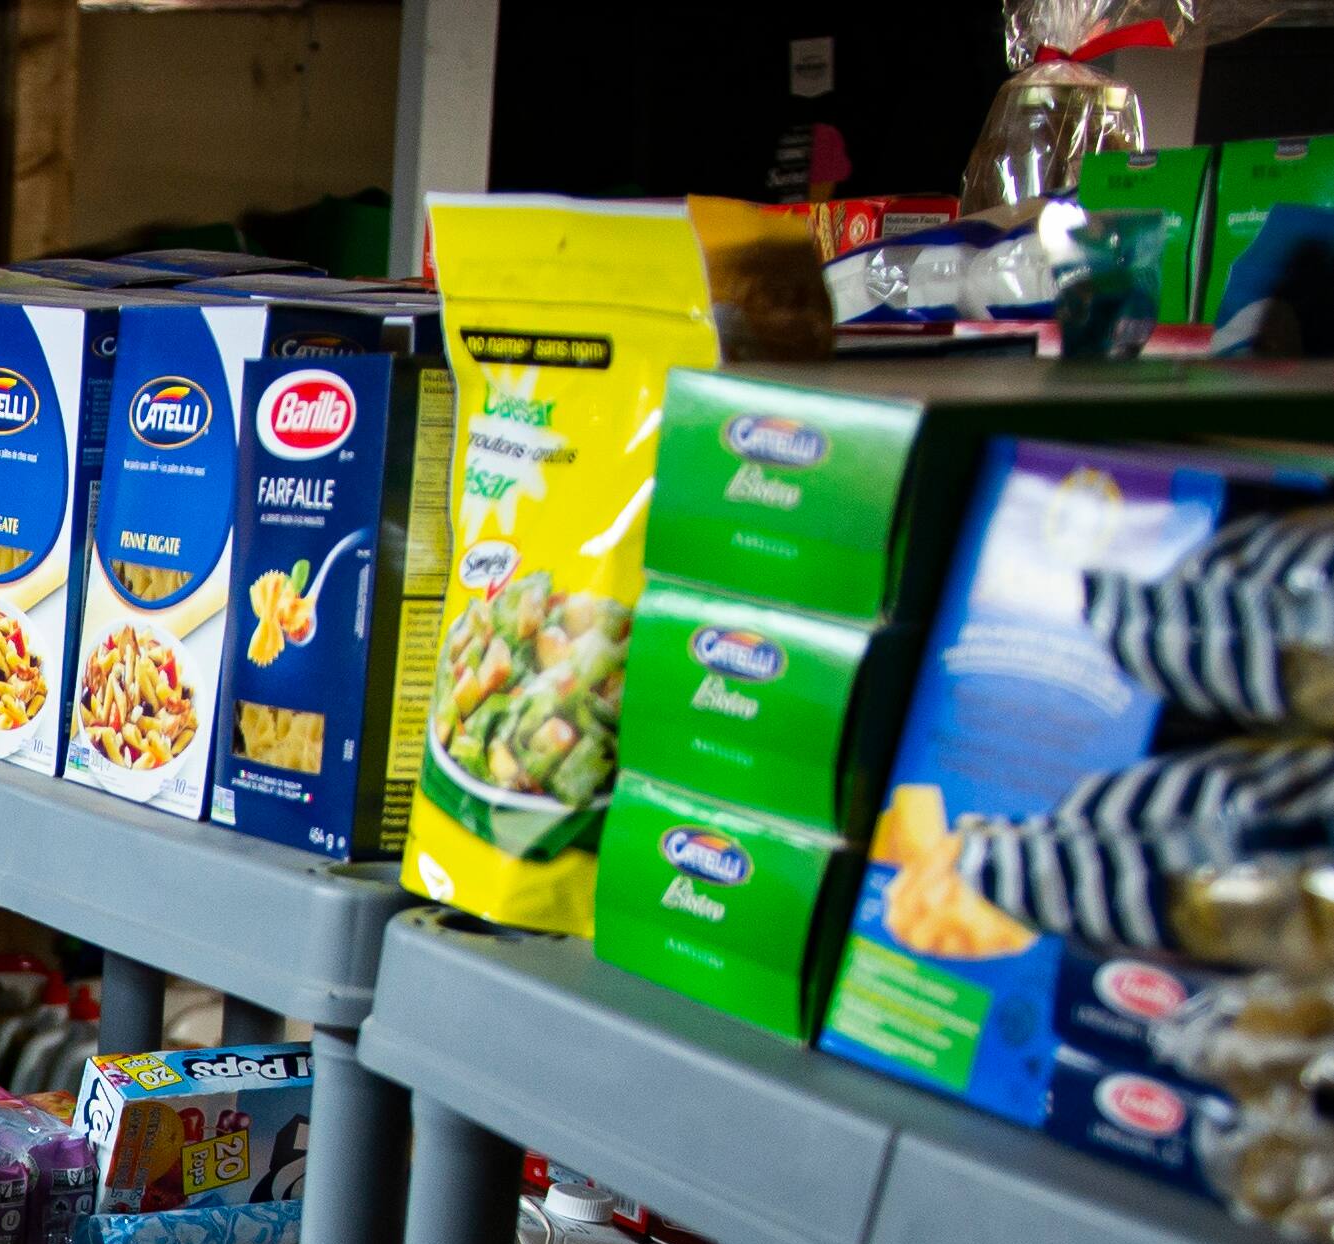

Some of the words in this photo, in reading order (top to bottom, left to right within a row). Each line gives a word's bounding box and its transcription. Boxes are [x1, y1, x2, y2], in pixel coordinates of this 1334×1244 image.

[135, 392, 201, 432] CATELLI
[275, 391, 348, 434] Barilla
[257, 476, 336, 511] FARFALLE
[120, 530, 147, 549] PENNE
[148, 534, 182, 557] RIGATE
[137, 1065, 175, 1086] 20
[190, 1055, 288, 1081] Pops
[187, 1149, 211, 1186] Pops
[213, 1135, 245, 1181] 20
